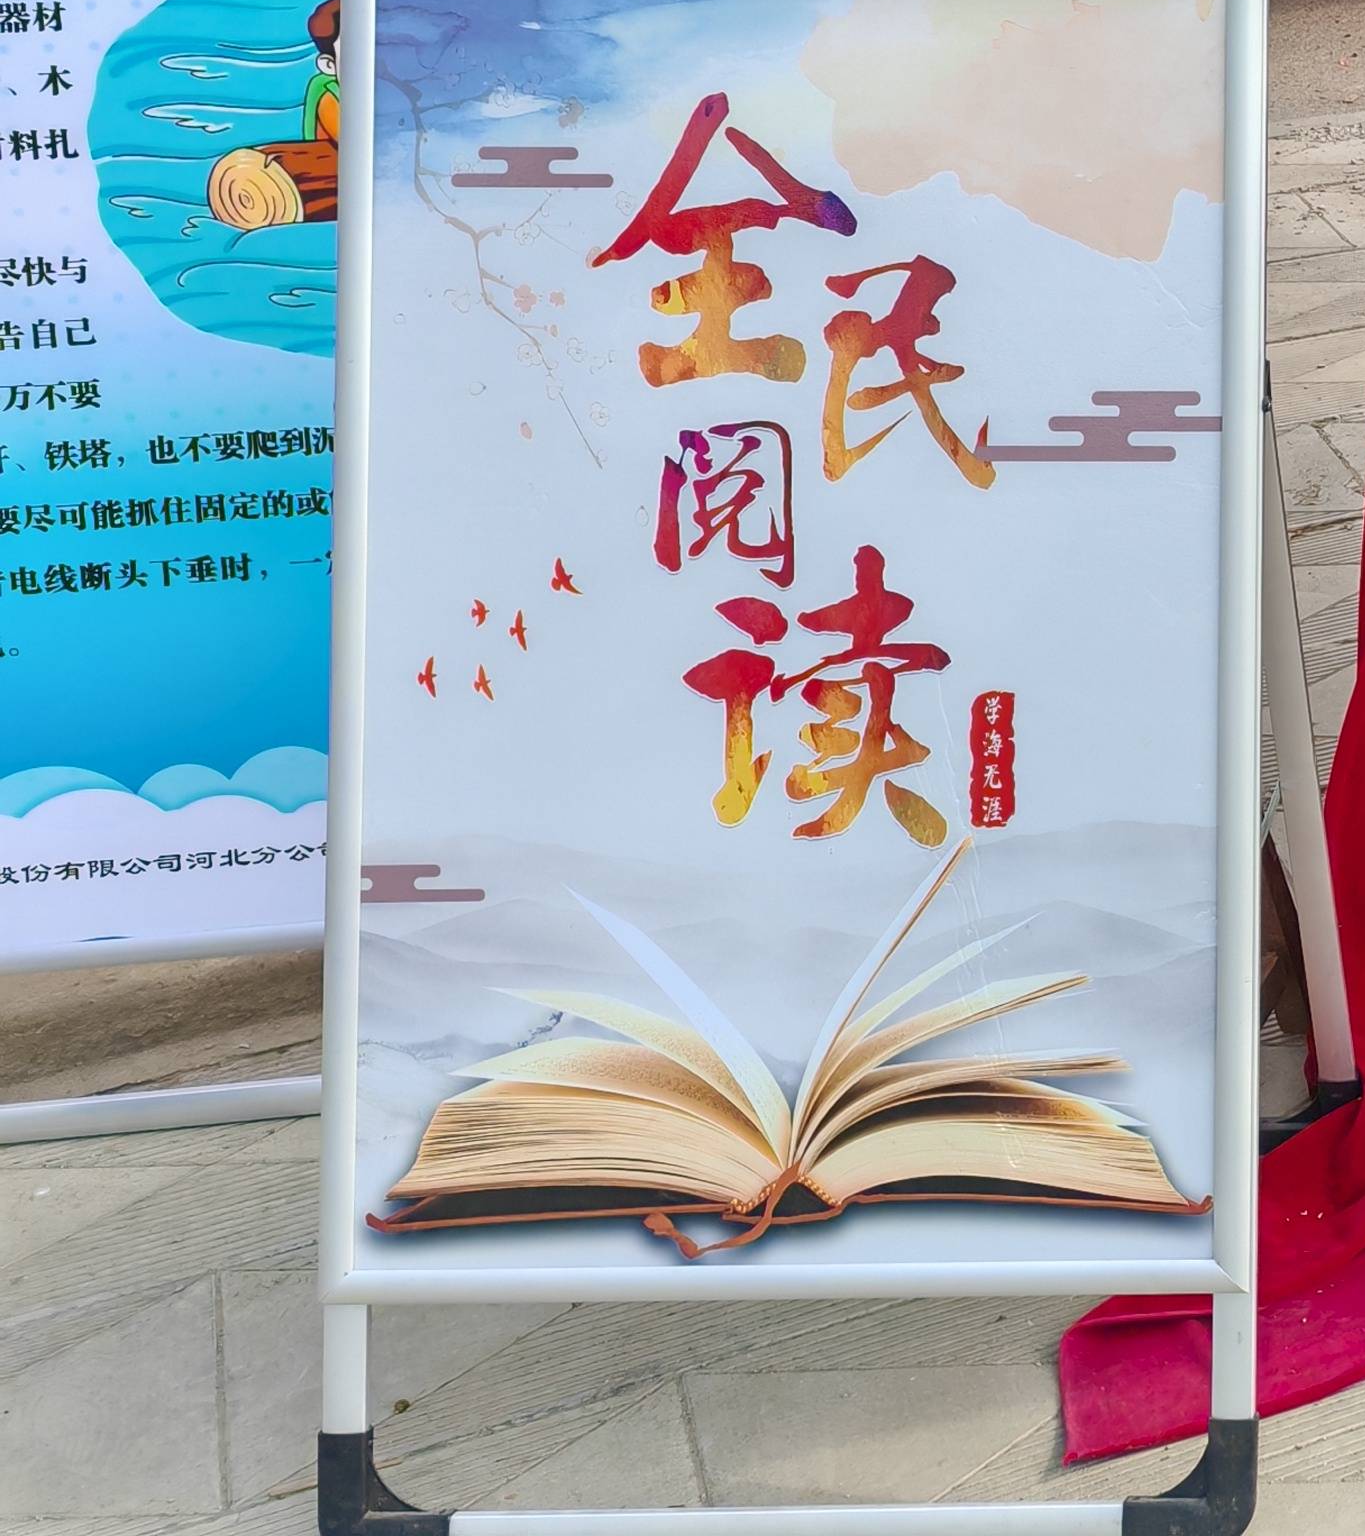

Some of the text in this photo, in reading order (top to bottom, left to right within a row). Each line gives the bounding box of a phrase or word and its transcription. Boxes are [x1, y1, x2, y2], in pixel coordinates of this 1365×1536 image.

[0, 127, 80, 162] 料扎
[0, 551, 335, 598] 电线断头下垂时，一
[981, 695, 1003, 823] 学海无涯
